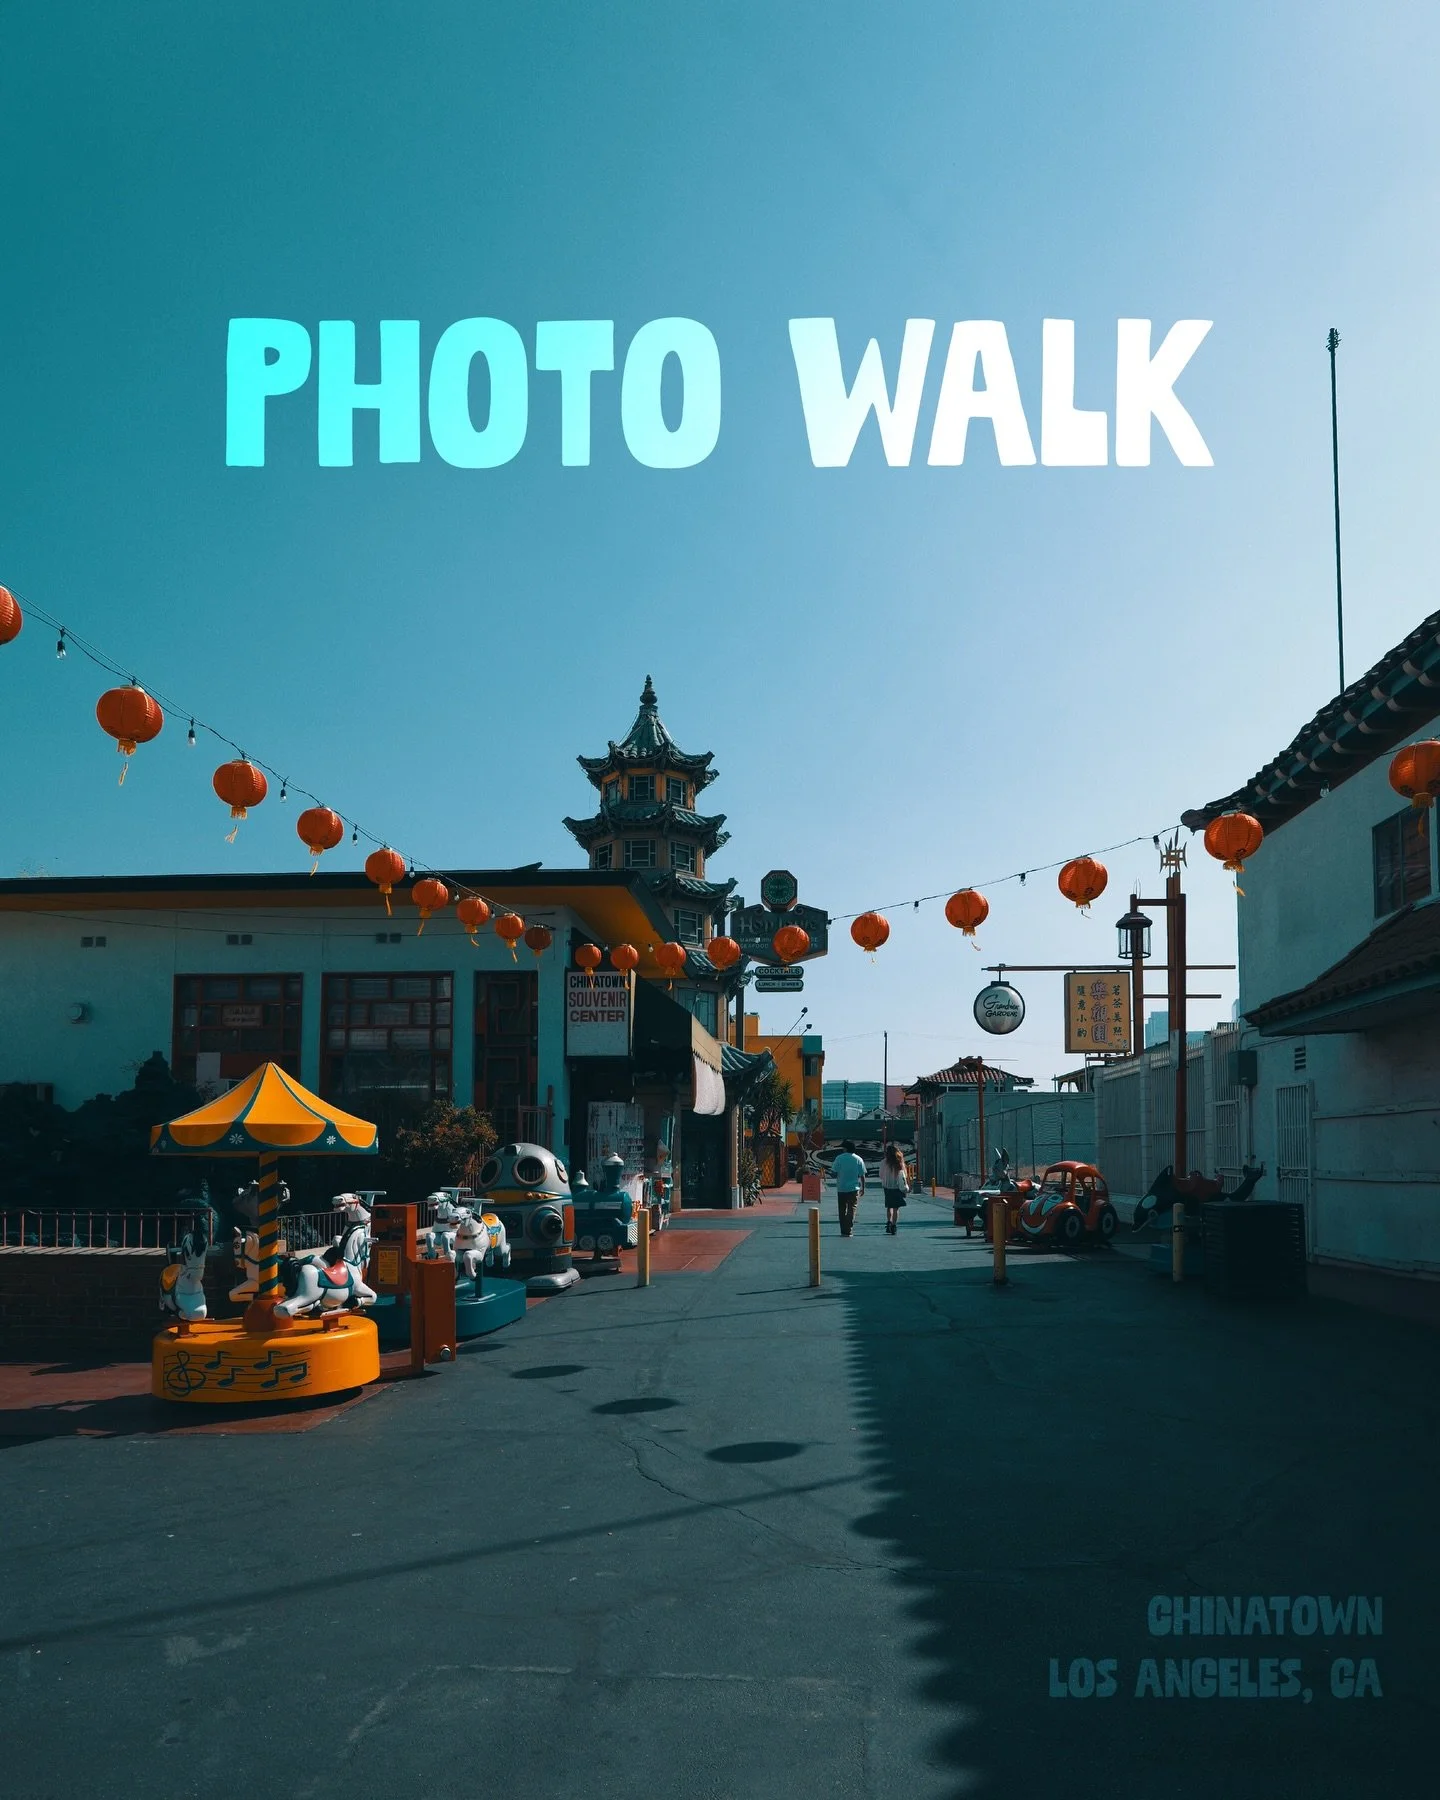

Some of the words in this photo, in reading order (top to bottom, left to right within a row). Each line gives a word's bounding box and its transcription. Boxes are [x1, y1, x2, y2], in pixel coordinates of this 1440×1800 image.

[570, 975, 626, 988] CHINATOWN
[569, 991, 627, 1008] SOUVENIR
[570, 1010, 625, 1022] CENTER
